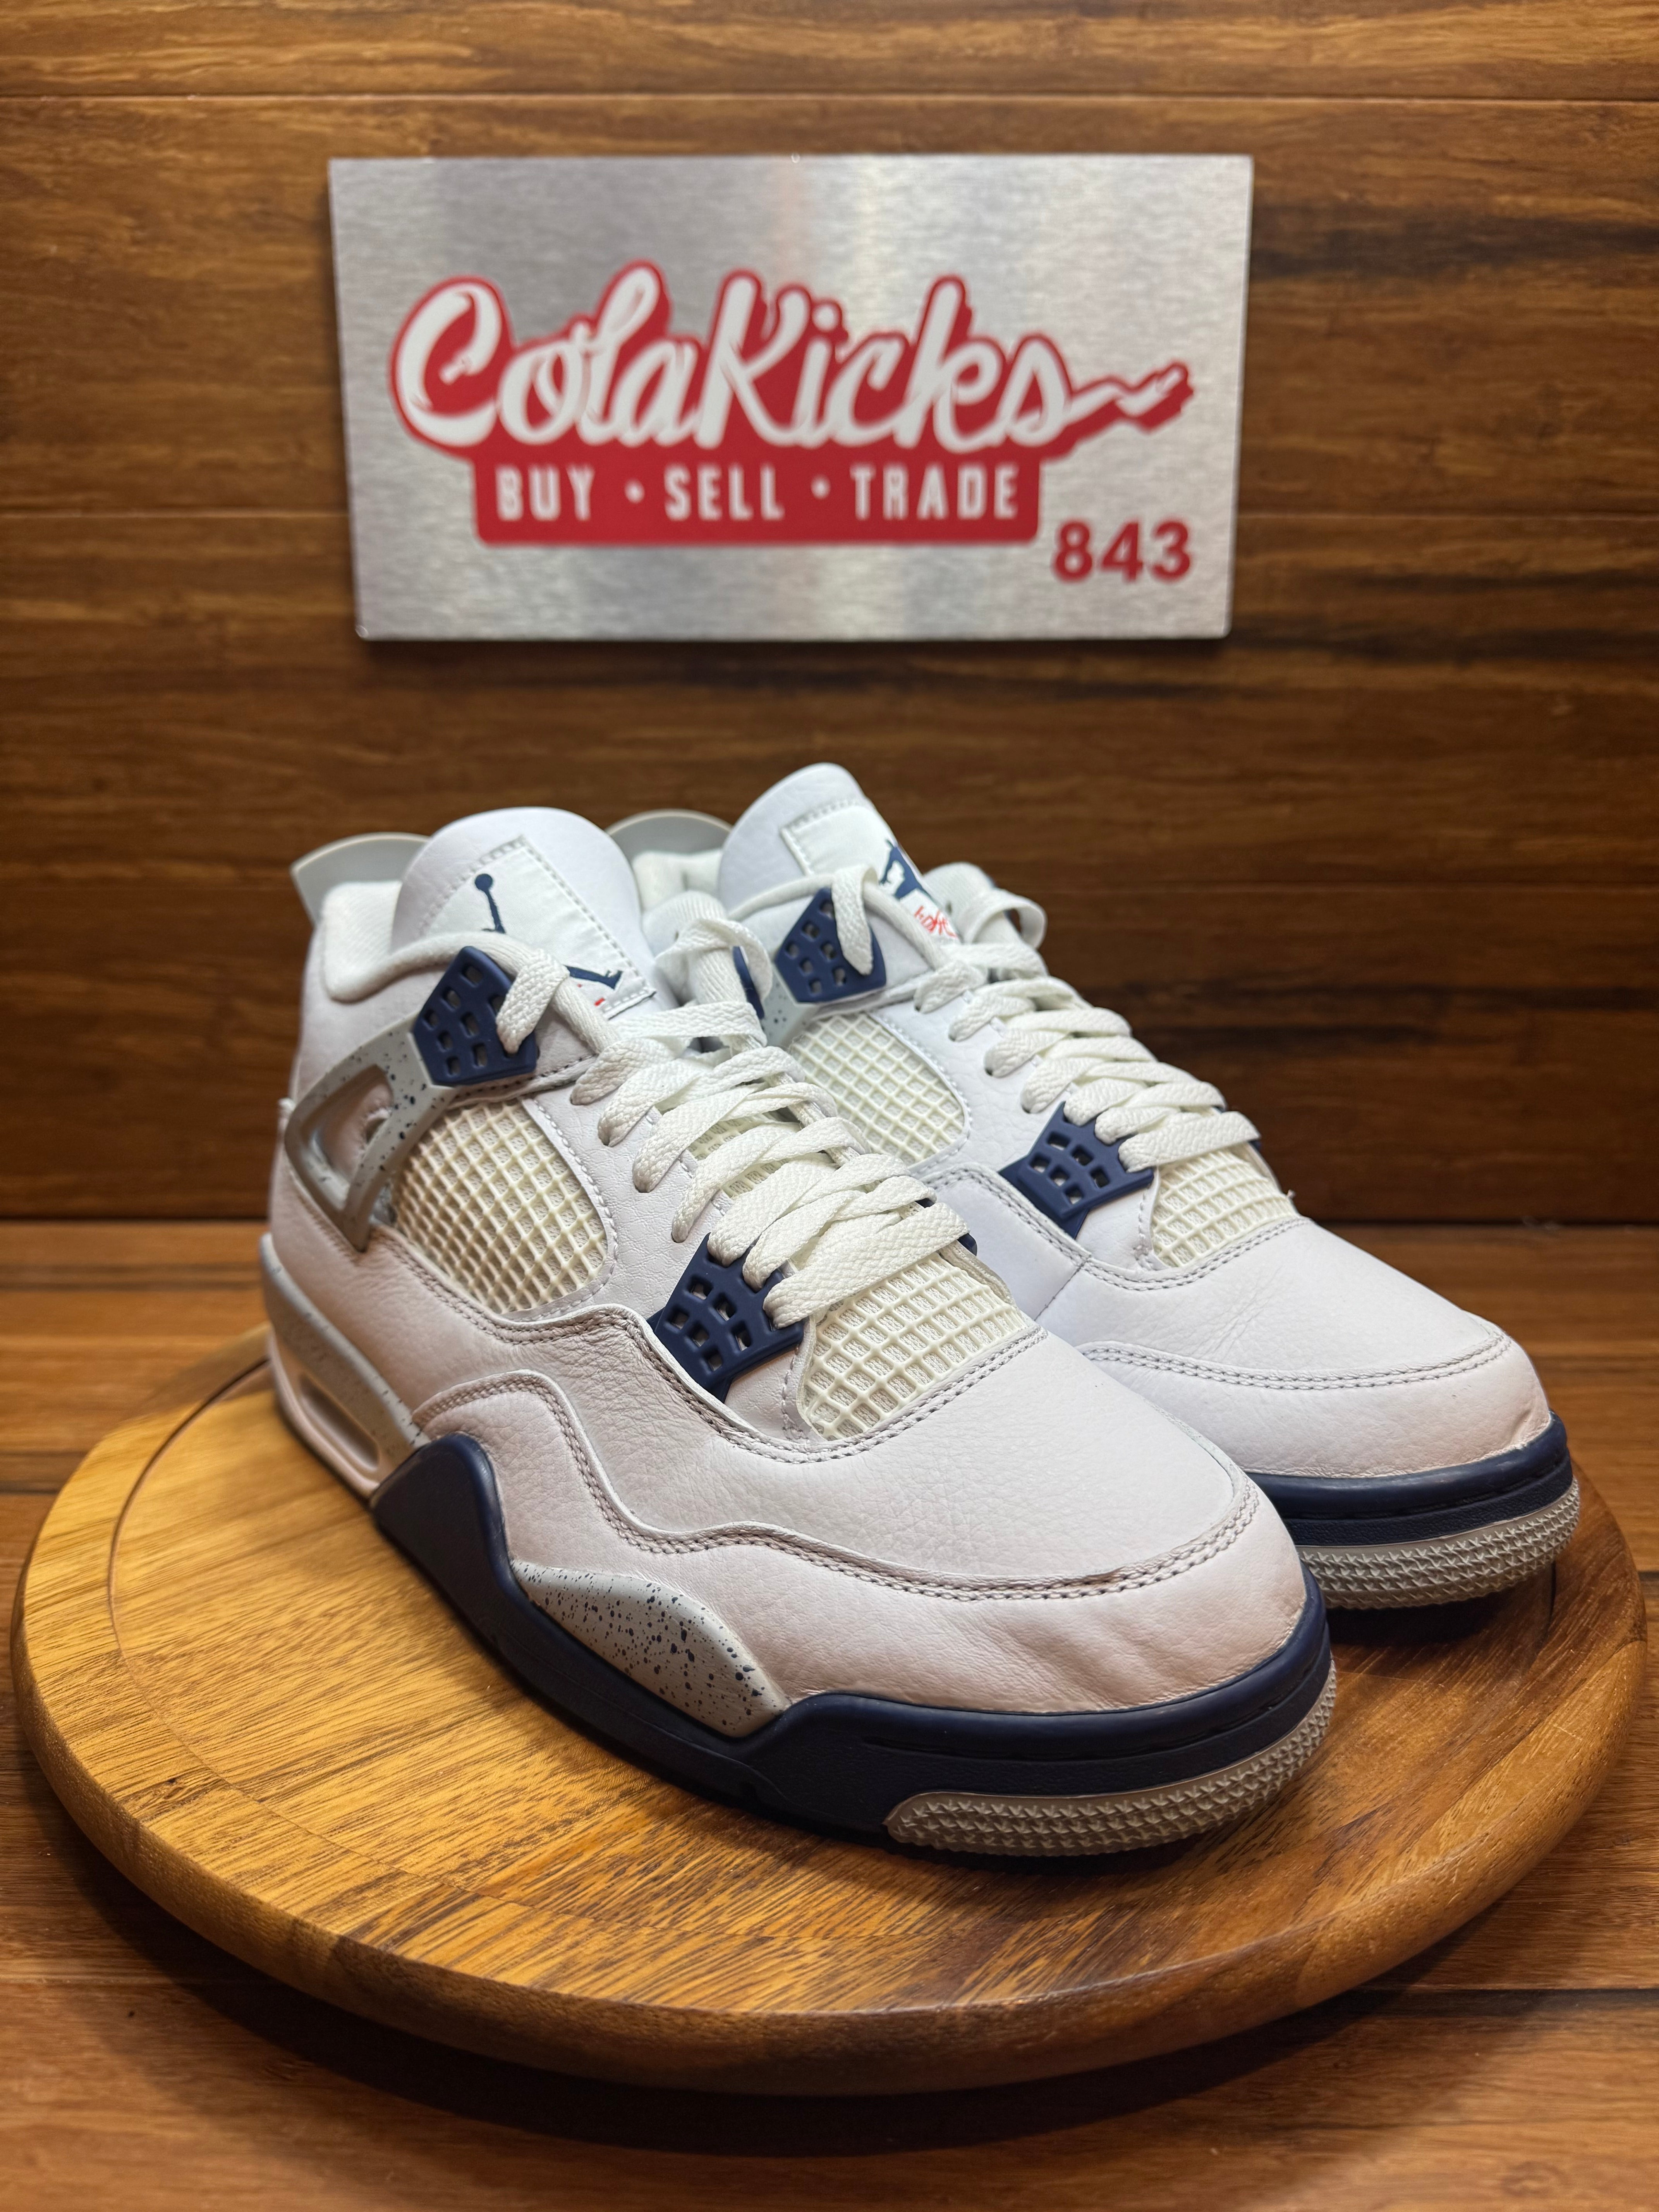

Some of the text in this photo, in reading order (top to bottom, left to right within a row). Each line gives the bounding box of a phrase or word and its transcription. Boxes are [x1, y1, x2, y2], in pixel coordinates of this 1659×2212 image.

[393, 262, 1193, 451] ColaKicks
[497, 466, 1017, 519] BUY SELL TRADE
[1053, 519, 1192, 582] 843
